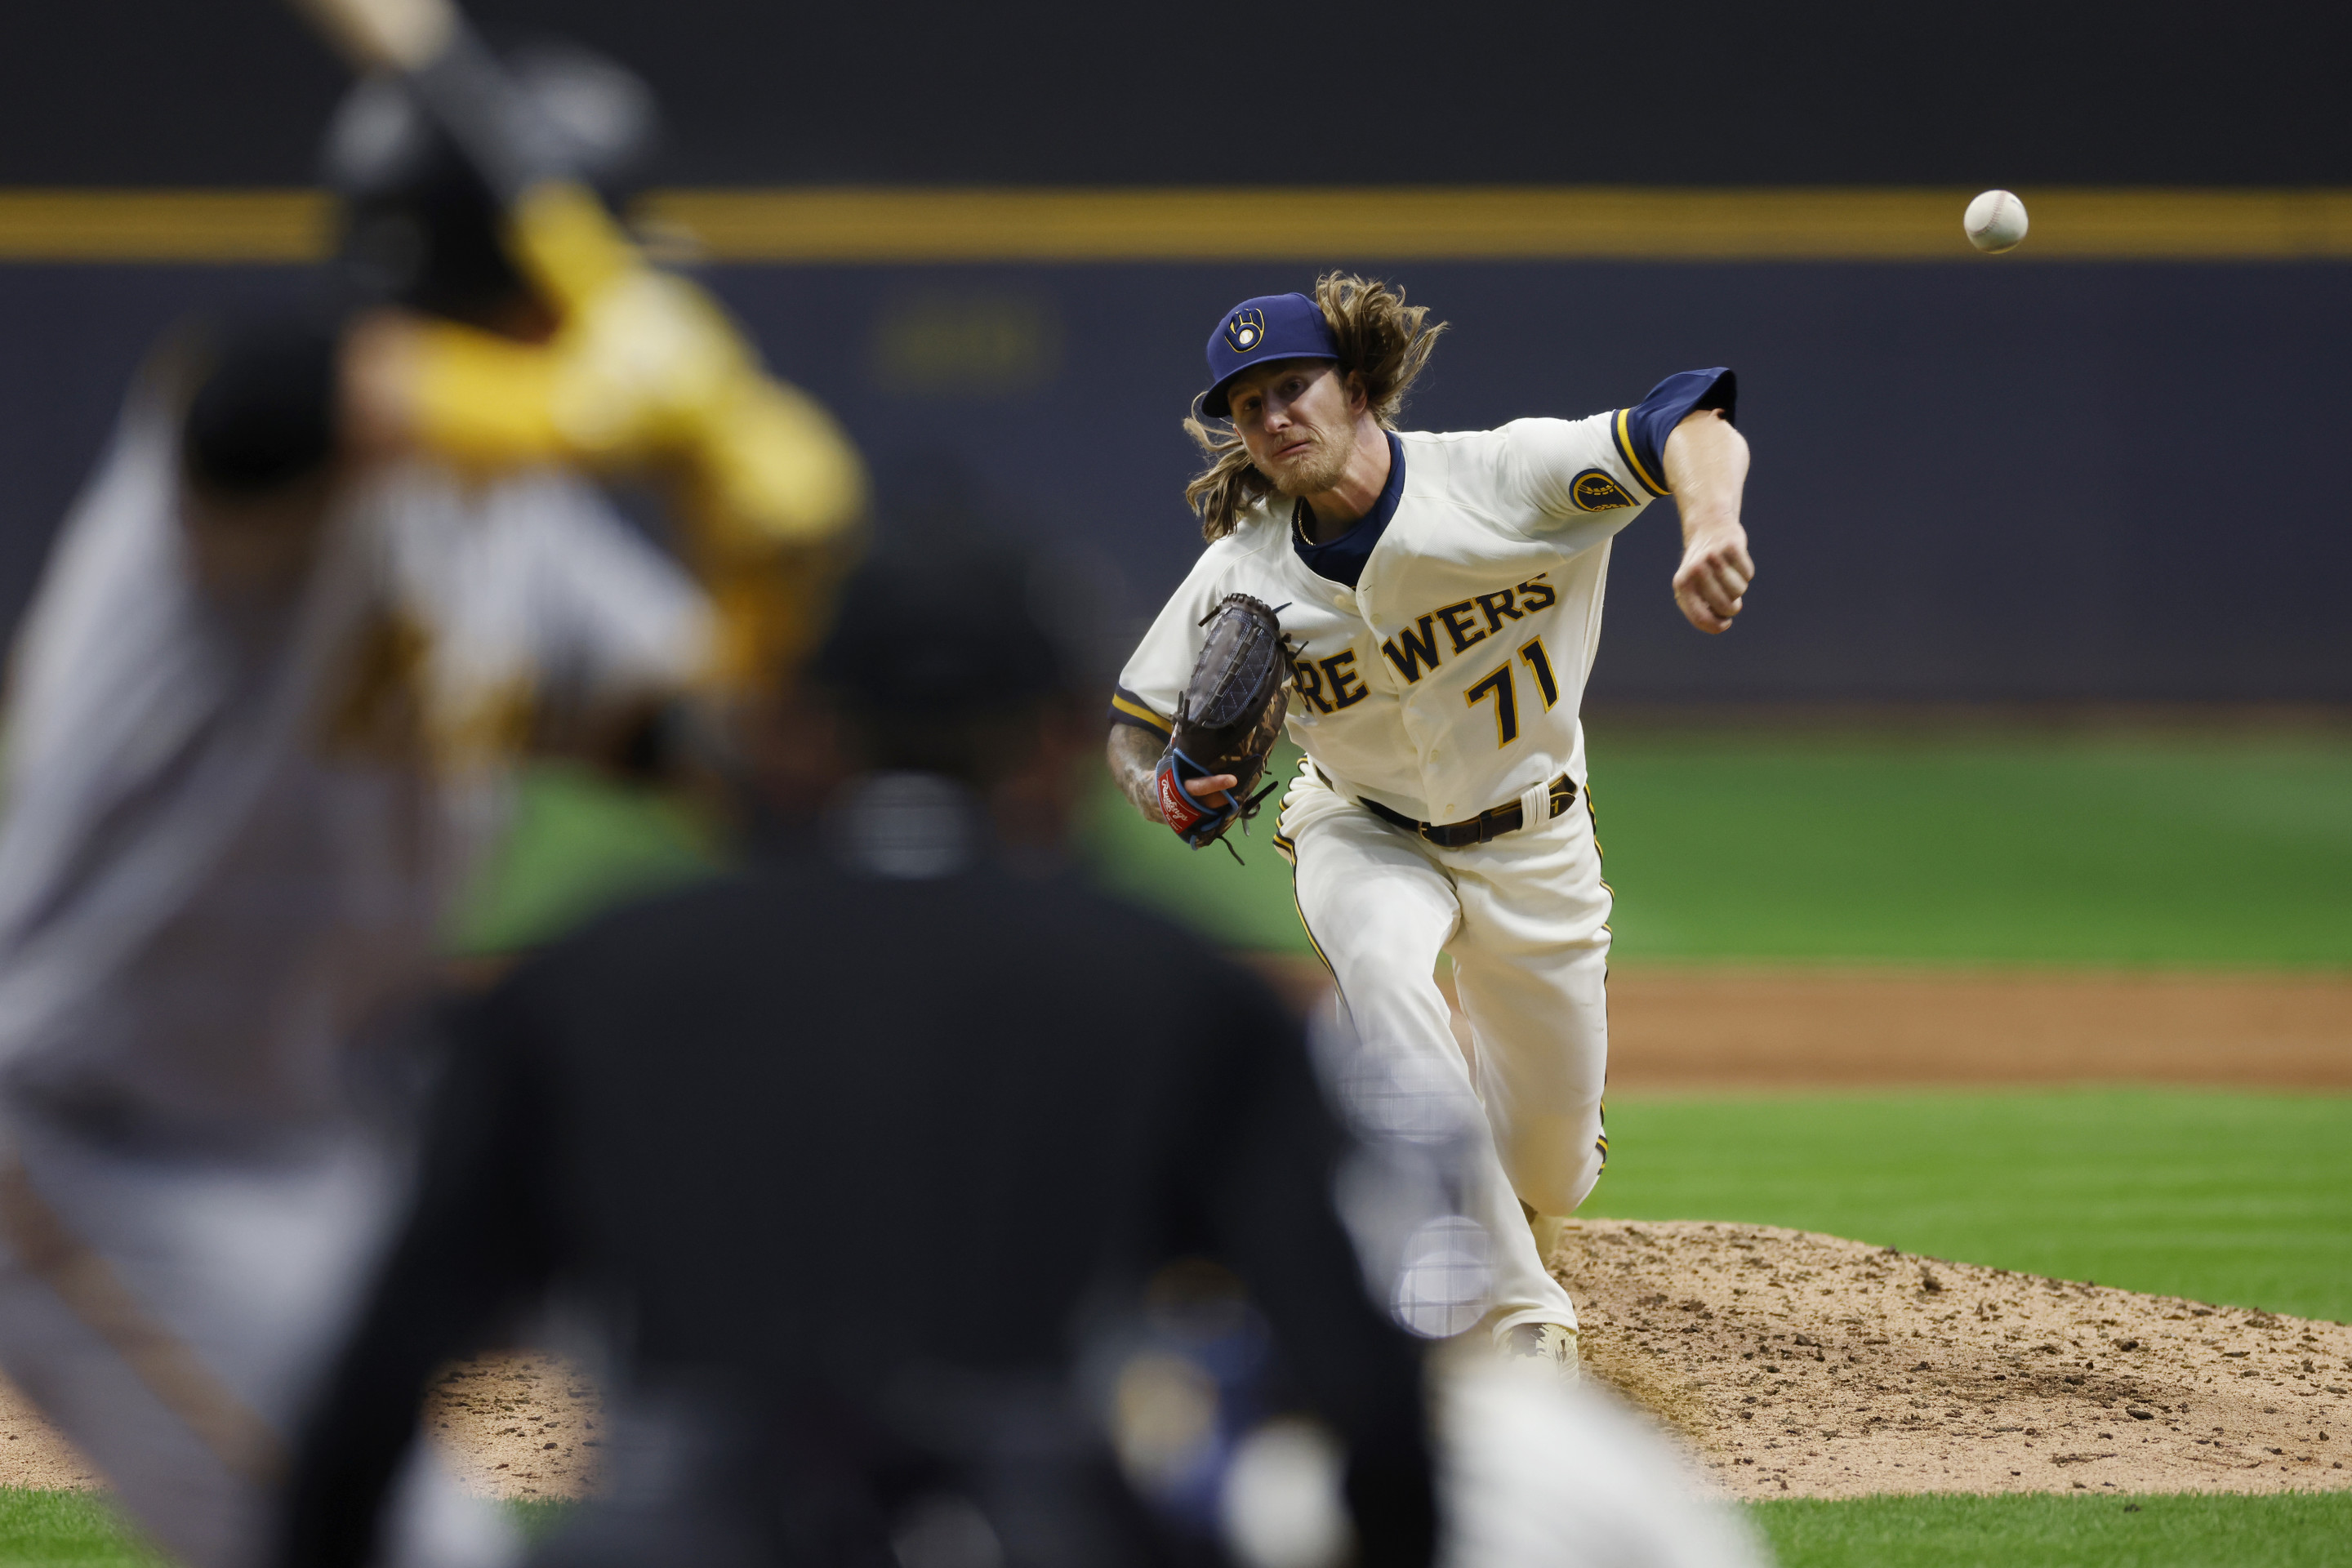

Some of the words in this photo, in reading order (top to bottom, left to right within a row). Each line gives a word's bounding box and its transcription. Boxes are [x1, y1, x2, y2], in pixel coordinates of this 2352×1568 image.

[1290, 572, 1557, 715] REWERS
[1463, 634, 1560, 750] 71
[1161, 778, 1188, 822] Rawlings
